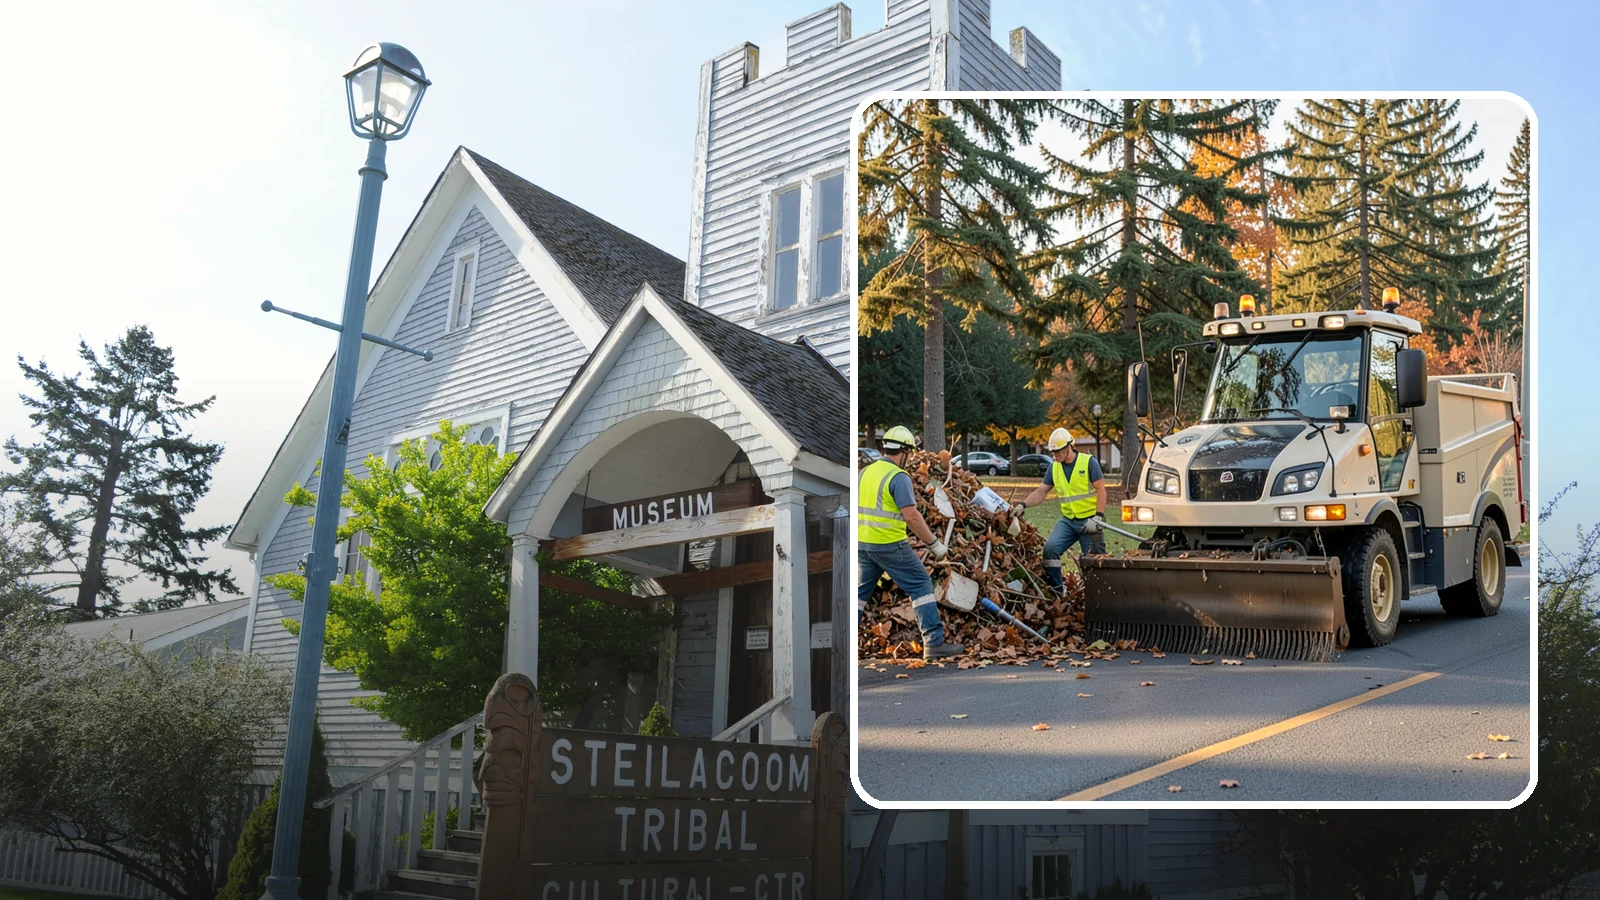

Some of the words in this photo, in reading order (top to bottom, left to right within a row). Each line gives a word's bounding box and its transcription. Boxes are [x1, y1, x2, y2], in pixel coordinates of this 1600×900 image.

[613, 491, 714, 531] MUSEUM
[550, 738, 809, 792] STEILACOOM
[615, 807, 757, 852] TRIBAL
